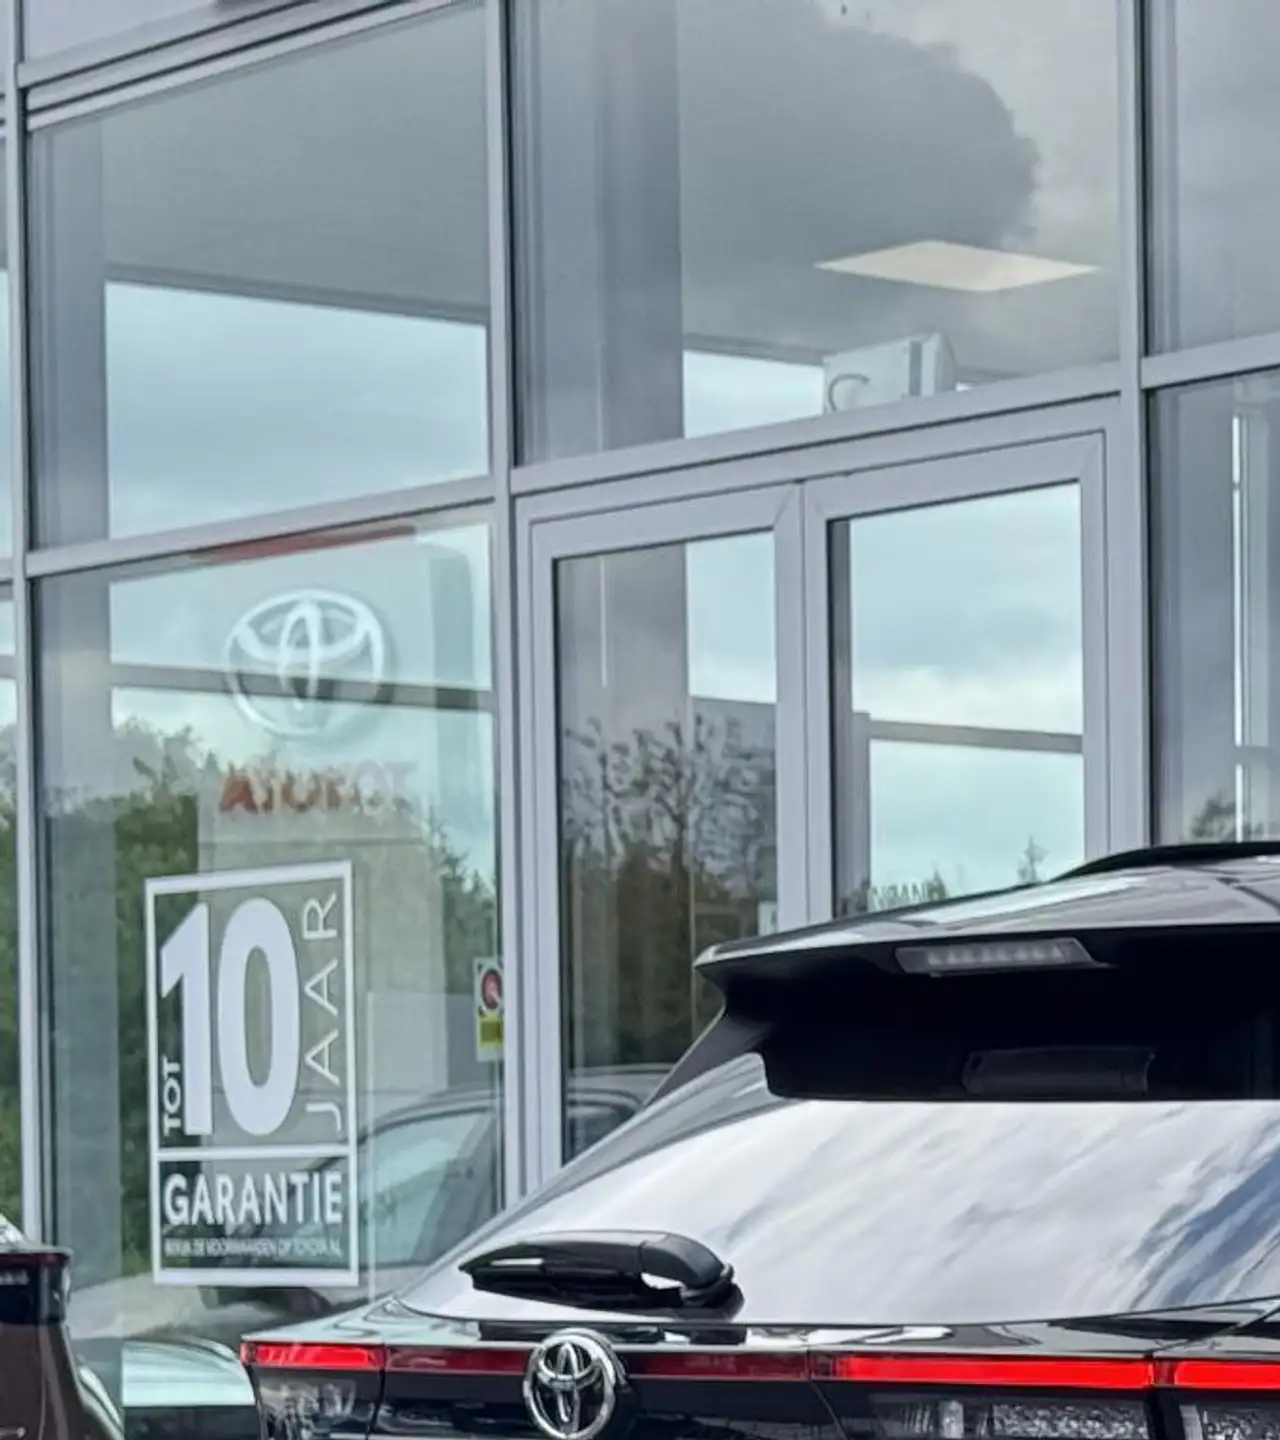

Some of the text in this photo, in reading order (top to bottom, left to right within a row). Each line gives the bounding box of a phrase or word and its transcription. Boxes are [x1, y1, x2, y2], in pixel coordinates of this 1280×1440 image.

[160, 897, 300, 1137] 10
[303, 891, 341, 1132] JAAR
[162, 1056, 183, 1137] TOT
[164, 1171, 344, 1226] GARANTIE
